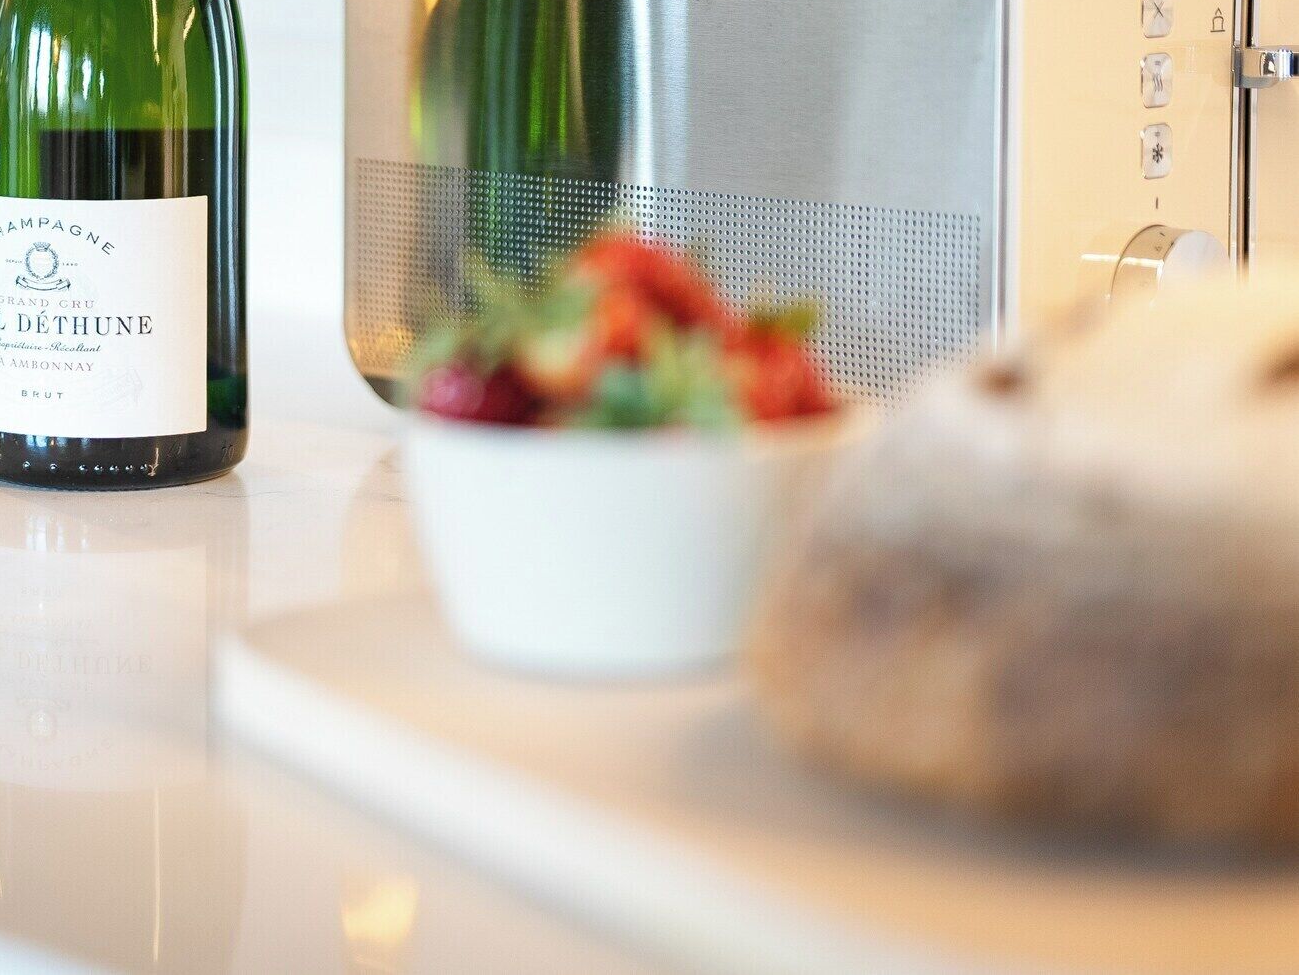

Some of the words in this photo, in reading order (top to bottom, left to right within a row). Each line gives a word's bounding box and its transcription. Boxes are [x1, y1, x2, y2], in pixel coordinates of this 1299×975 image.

[59, 299, 95, 309] CRU
[17, 310, 154, 336] DÉTHUNE
[9, 358, 95, 373] AMBONNAY
[21, 389, 64, 400] BRUT
